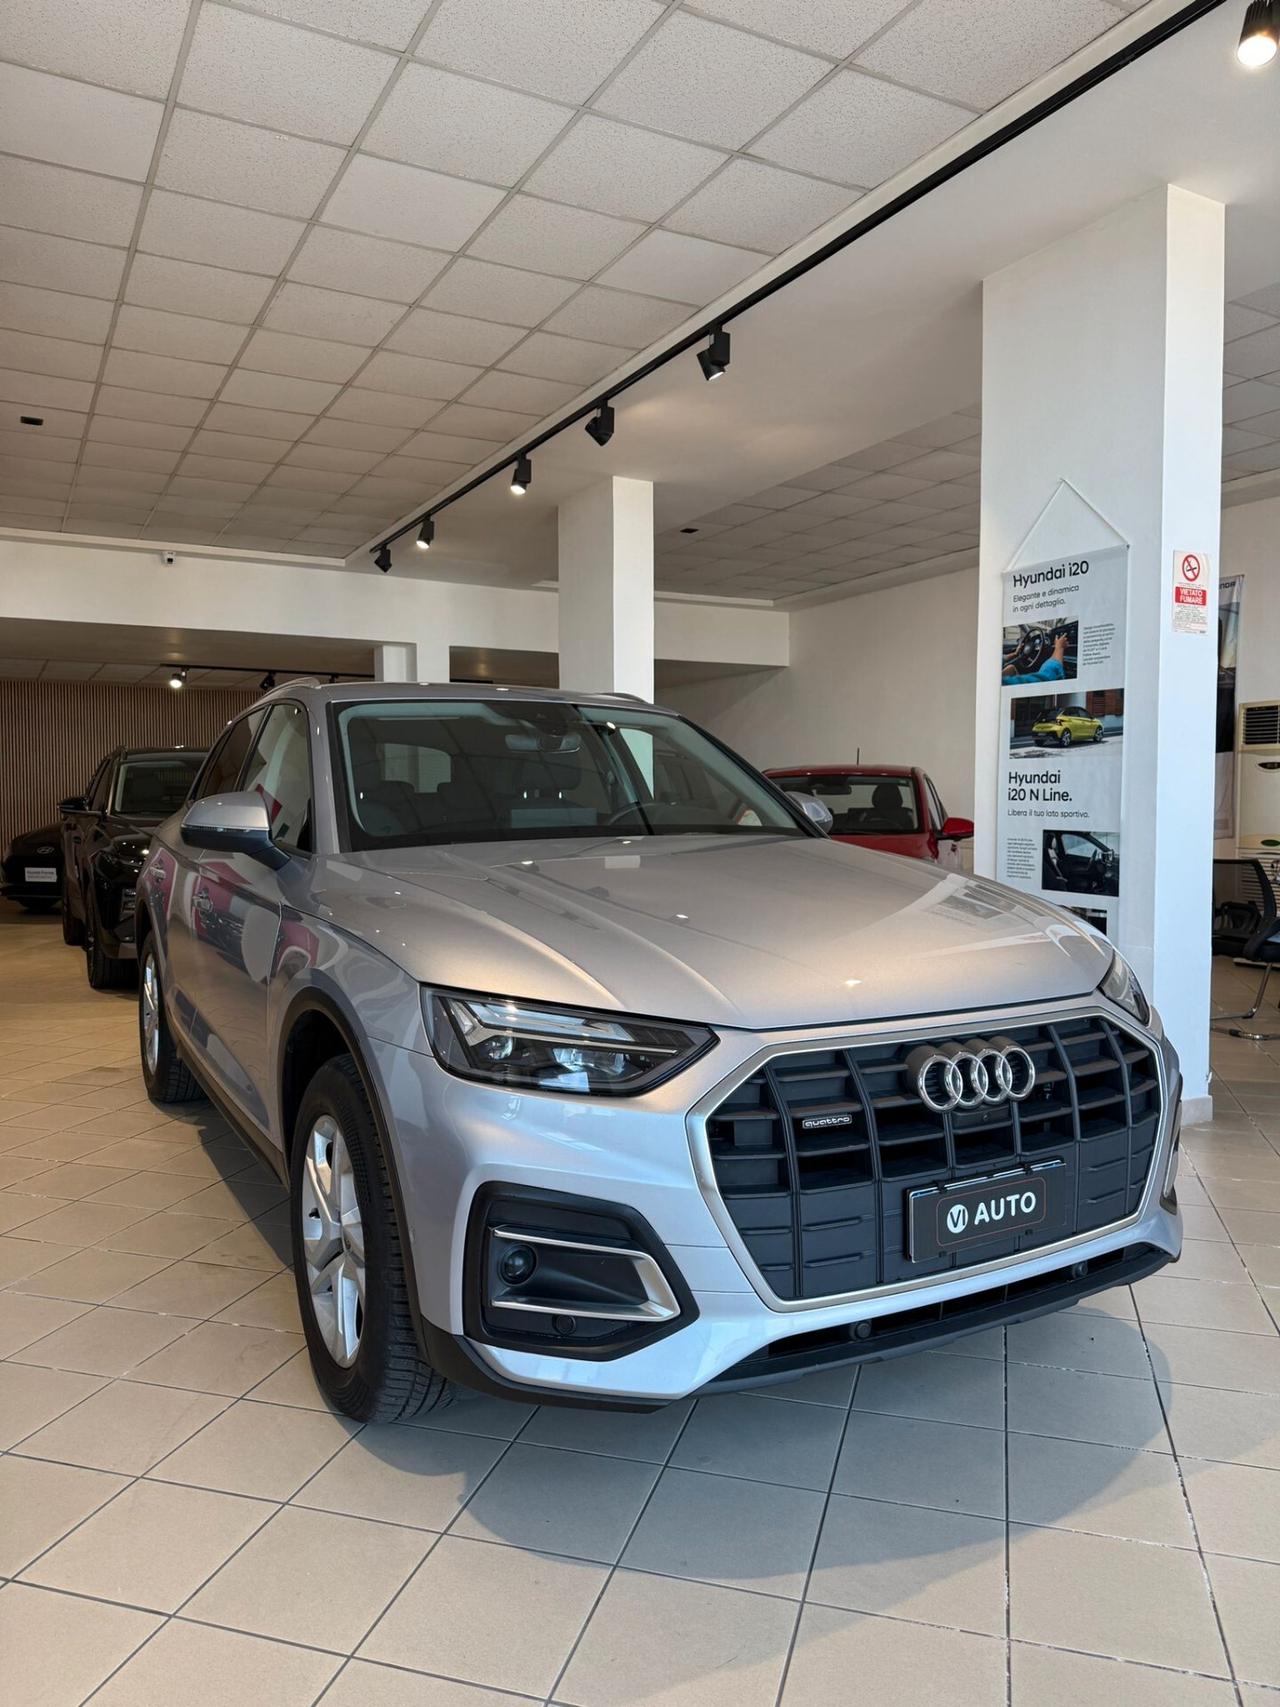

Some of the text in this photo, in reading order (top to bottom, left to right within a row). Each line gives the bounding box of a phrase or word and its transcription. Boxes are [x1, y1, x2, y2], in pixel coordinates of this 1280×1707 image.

[1013, 560, 1089, 588] Hyundai i20
[1013, 592, 1041, 603] Elegante
[1047, 585, 1080, 597] dinamico
[1012, 605, 1019, 613] in
[1019, 604, 1034, 613] ogni
[1008, 770, 1061, 787] Hyundai
[1008, 787, 1073, 802] i20 N Line.
[1007, 808, 1090, 819] Libera il tuo lato sportivo.
[804, 1116, 851, 1128] quattro
[974, 1191, 1037, 1226] AUTO
